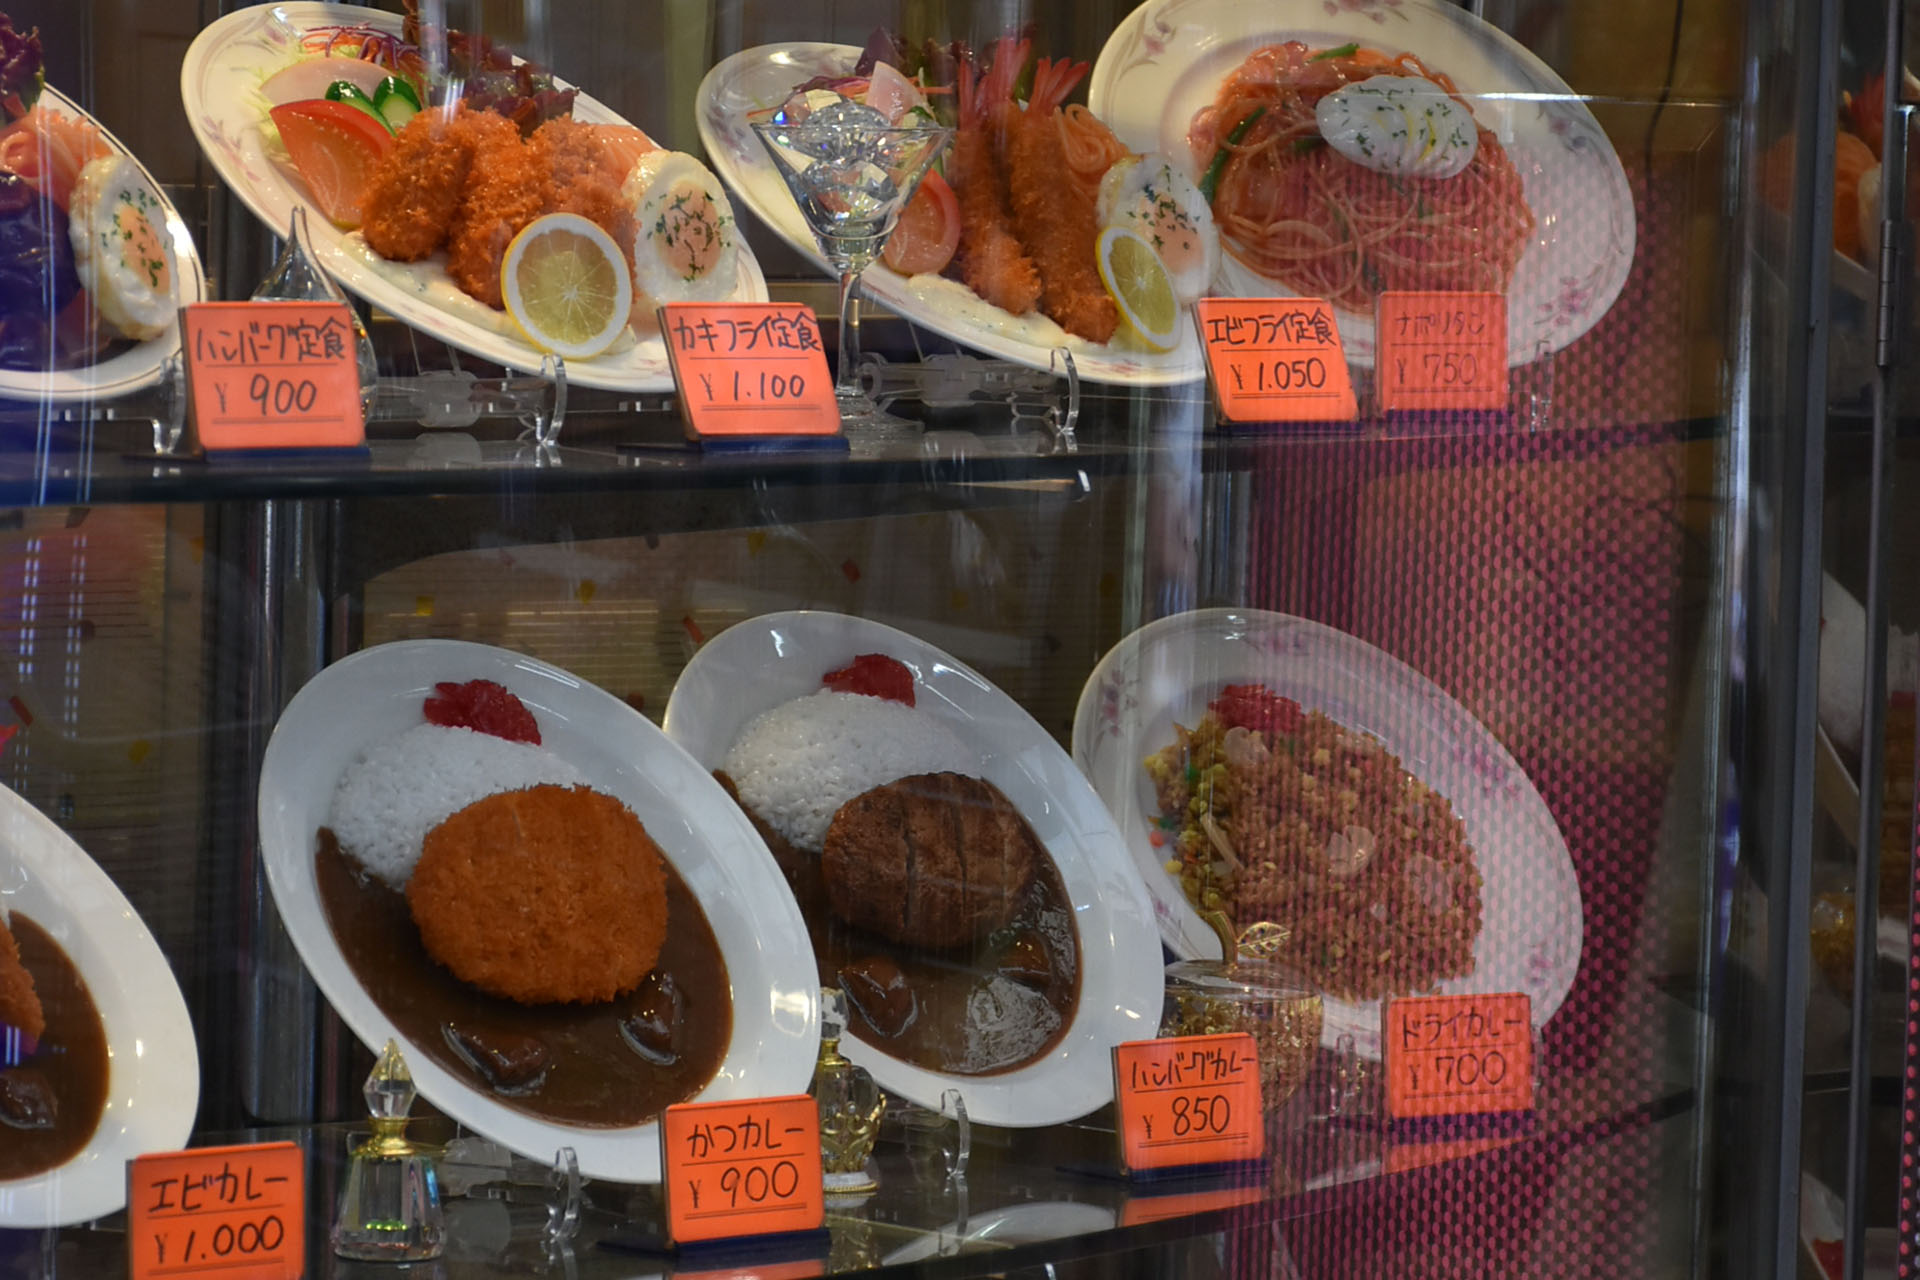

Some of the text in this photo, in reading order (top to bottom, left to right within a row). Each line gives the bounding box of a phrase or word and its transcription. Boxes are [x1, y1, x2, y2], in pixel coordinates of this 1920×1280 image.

[197, 316, 347, 363] ハンバーグ定食
[673, 311, 822, 352] カキフライ定食
[1207, 307, 1336, 345] エビフライ定食
[1394, 311, 1485, 337] ナポリタン
[1403, 1006, 1522, 1048] ドライカレー
[1132, 1048, 1256, 1088] ハンバーグカレー
[687, 1115, 804, 1158] かつカレー
[148, 1162, 288, 1213] エビカレー
